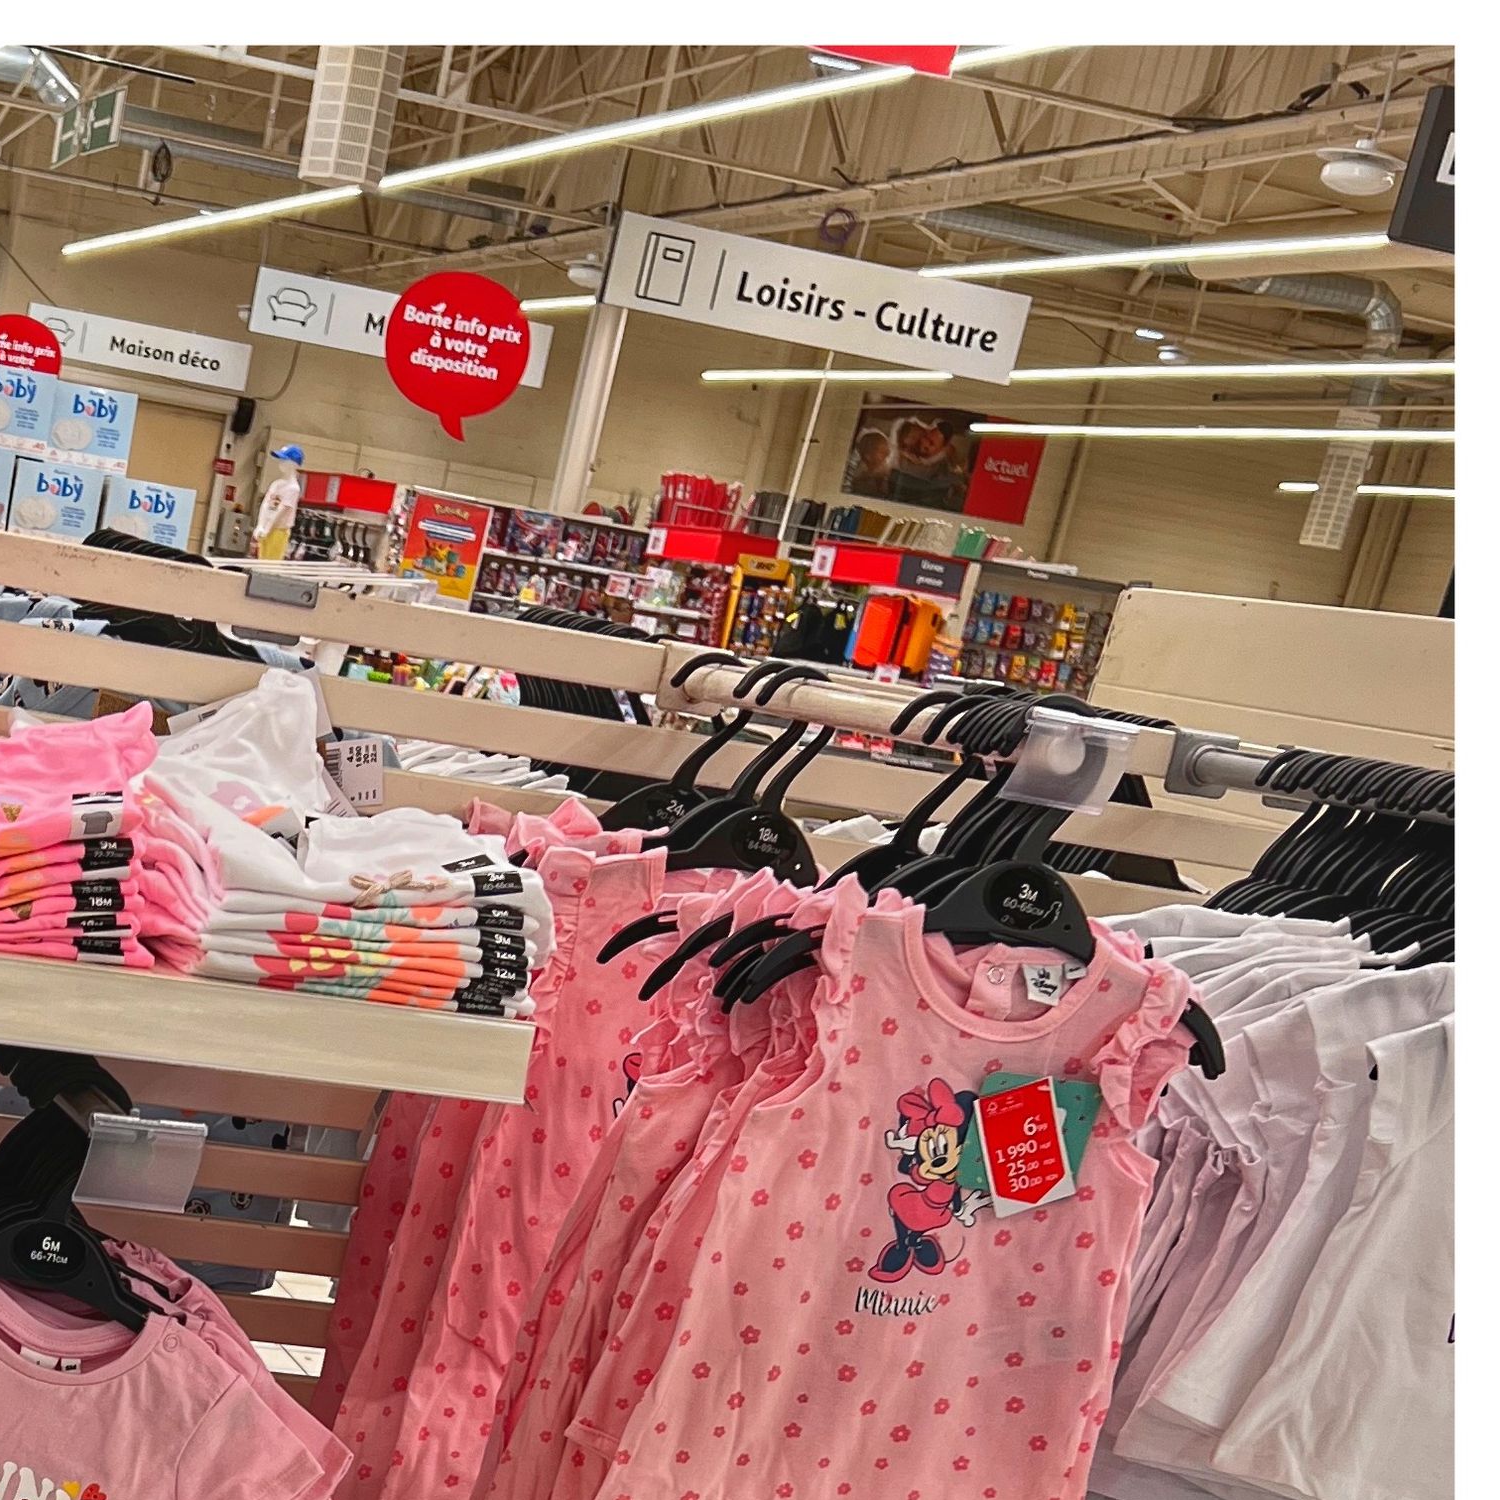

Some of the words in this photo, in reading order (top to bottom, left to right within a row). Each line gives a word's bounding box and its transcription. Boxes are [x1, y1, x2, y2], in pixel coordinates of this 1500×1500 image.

[403, 304, 452, 331] Borne
[453, 312, 487, 337] info
[487, 319, 522, 346] prix
[736, 272, 844, 322] Loisirs
[875, 302, 999, 355] Culture
[109, 335, 174, 363] Maison
[179, 347, 221, 371] déco
[429, 330, 441, 348] à
[444, 338, 487, 358] votre
[409, 347, 498, 380] disposition
[73, 394, 118, 423] baby
[37, 472, 83, 503] baby
[129, 488, 178, 520] baby
[758, 828, 779, 843] 18M
[88, 896, 113, 907] 18M
[1018, 884, 1039, 902] 3M
[494, 968, 516, 980] 12M
[30, 1250, 68, 1264] 66-71CM
[42, 1236, 61, 1253] 6M
[855, 1286, 937, 1316] Minnie
